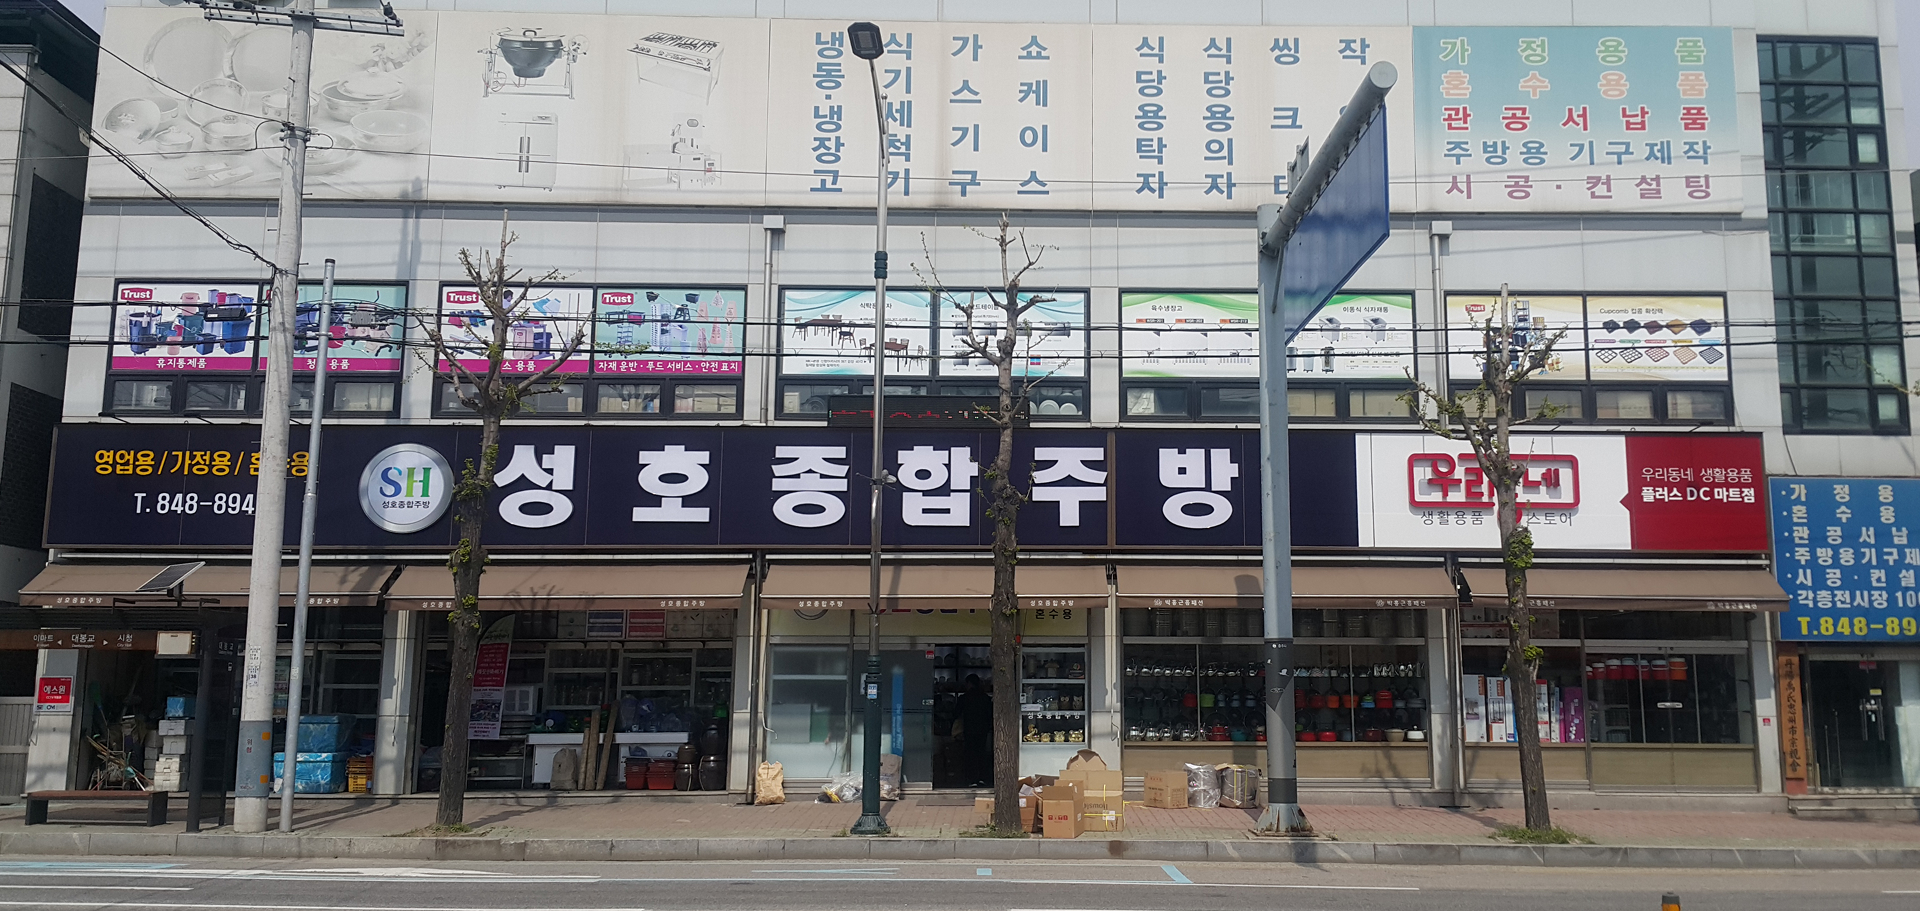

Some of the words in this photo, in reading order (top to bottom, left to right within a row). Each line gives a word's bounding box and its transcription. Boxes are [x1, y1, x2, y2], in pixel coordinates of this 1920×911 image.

[948, 33, 983, 197] 가스기구
[1016, 35, 1050, 196] 쇼케이스
[1134, 36, 1169, 199] 식당용탁자
[1202, 36, 1237, 200] 식당용의자
[122, 288, 151, 300] Trust
[448, 293, 479, 302] Trust
[603, 293, 632, 304] Trust
[1466, 304, 1484, 312] Trust
[1599, 307, 1629, 315] Cupcomb
[156, 358, 207, 369] 휴지통제품
[515, 360, 537, 372] 용품
[598, 361, 618, 372] 자재
[620, 361, 638, 372] 운반
[646, 361, 665, 372] 푸드
[666, 361, 693, 372] 서비스
[701, 361, 719, 372] 안전
[721, 361, 738, 372] 표지
[1640, 467, 1694, 482] 우리동네
[1699, 467, 1754, 483] 생활용품
[379, 466, 430, 498] SH
[493, 445, 1239, 528] 성호종합주방
[1640, 487, 1683, 502] 플러스
[1713, 487, 1755, 504] 마트점
[156, 492, 255, 514] 848-894
[381, 499, 430, 510] 성호종합주방
[1420, 510, 1484, 526] 생활용품
[1527, 512, 1573, 527] 스토어
[57, 597, 103, 605] 성호종합주방
[1797, 590, 1889, 609] 각층전시장
[1895, 590, 1920, 608] 10
[1797, 616, 1920, 636] T.848-89
[33, 634, 54, 642] 이마트
[71, 634, 95, 643] 대봉교
[117, 633, 133, 642] 시청
[43, 685, 65, 694] 에스원
[1027, 711, 1081, 720] 성호종합주방
